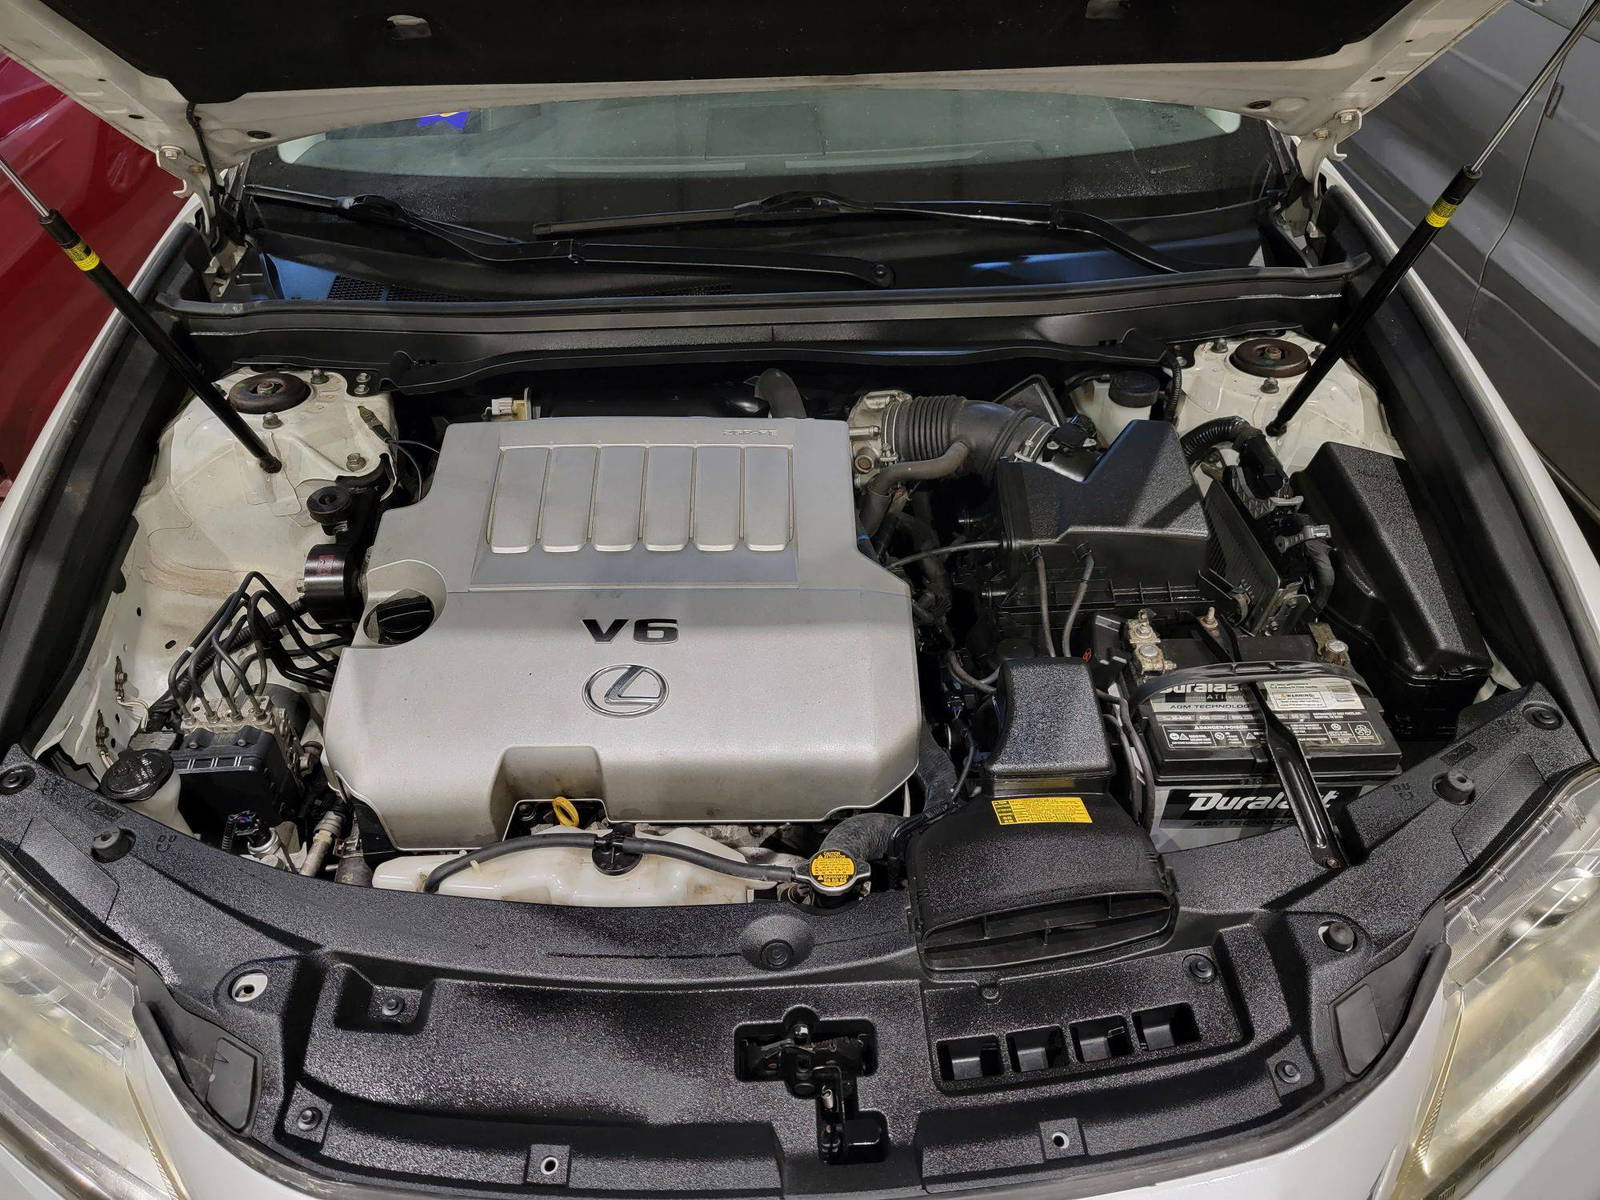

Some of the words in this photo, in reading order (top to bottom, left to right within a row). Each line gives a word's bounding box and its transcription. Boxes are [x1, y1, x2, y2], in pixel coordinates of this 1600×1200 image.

[581, 618, 679, 643] V6
[1160, 683, 1243, 694] uralas
[1188, 790, 1339, 811] Duralt
